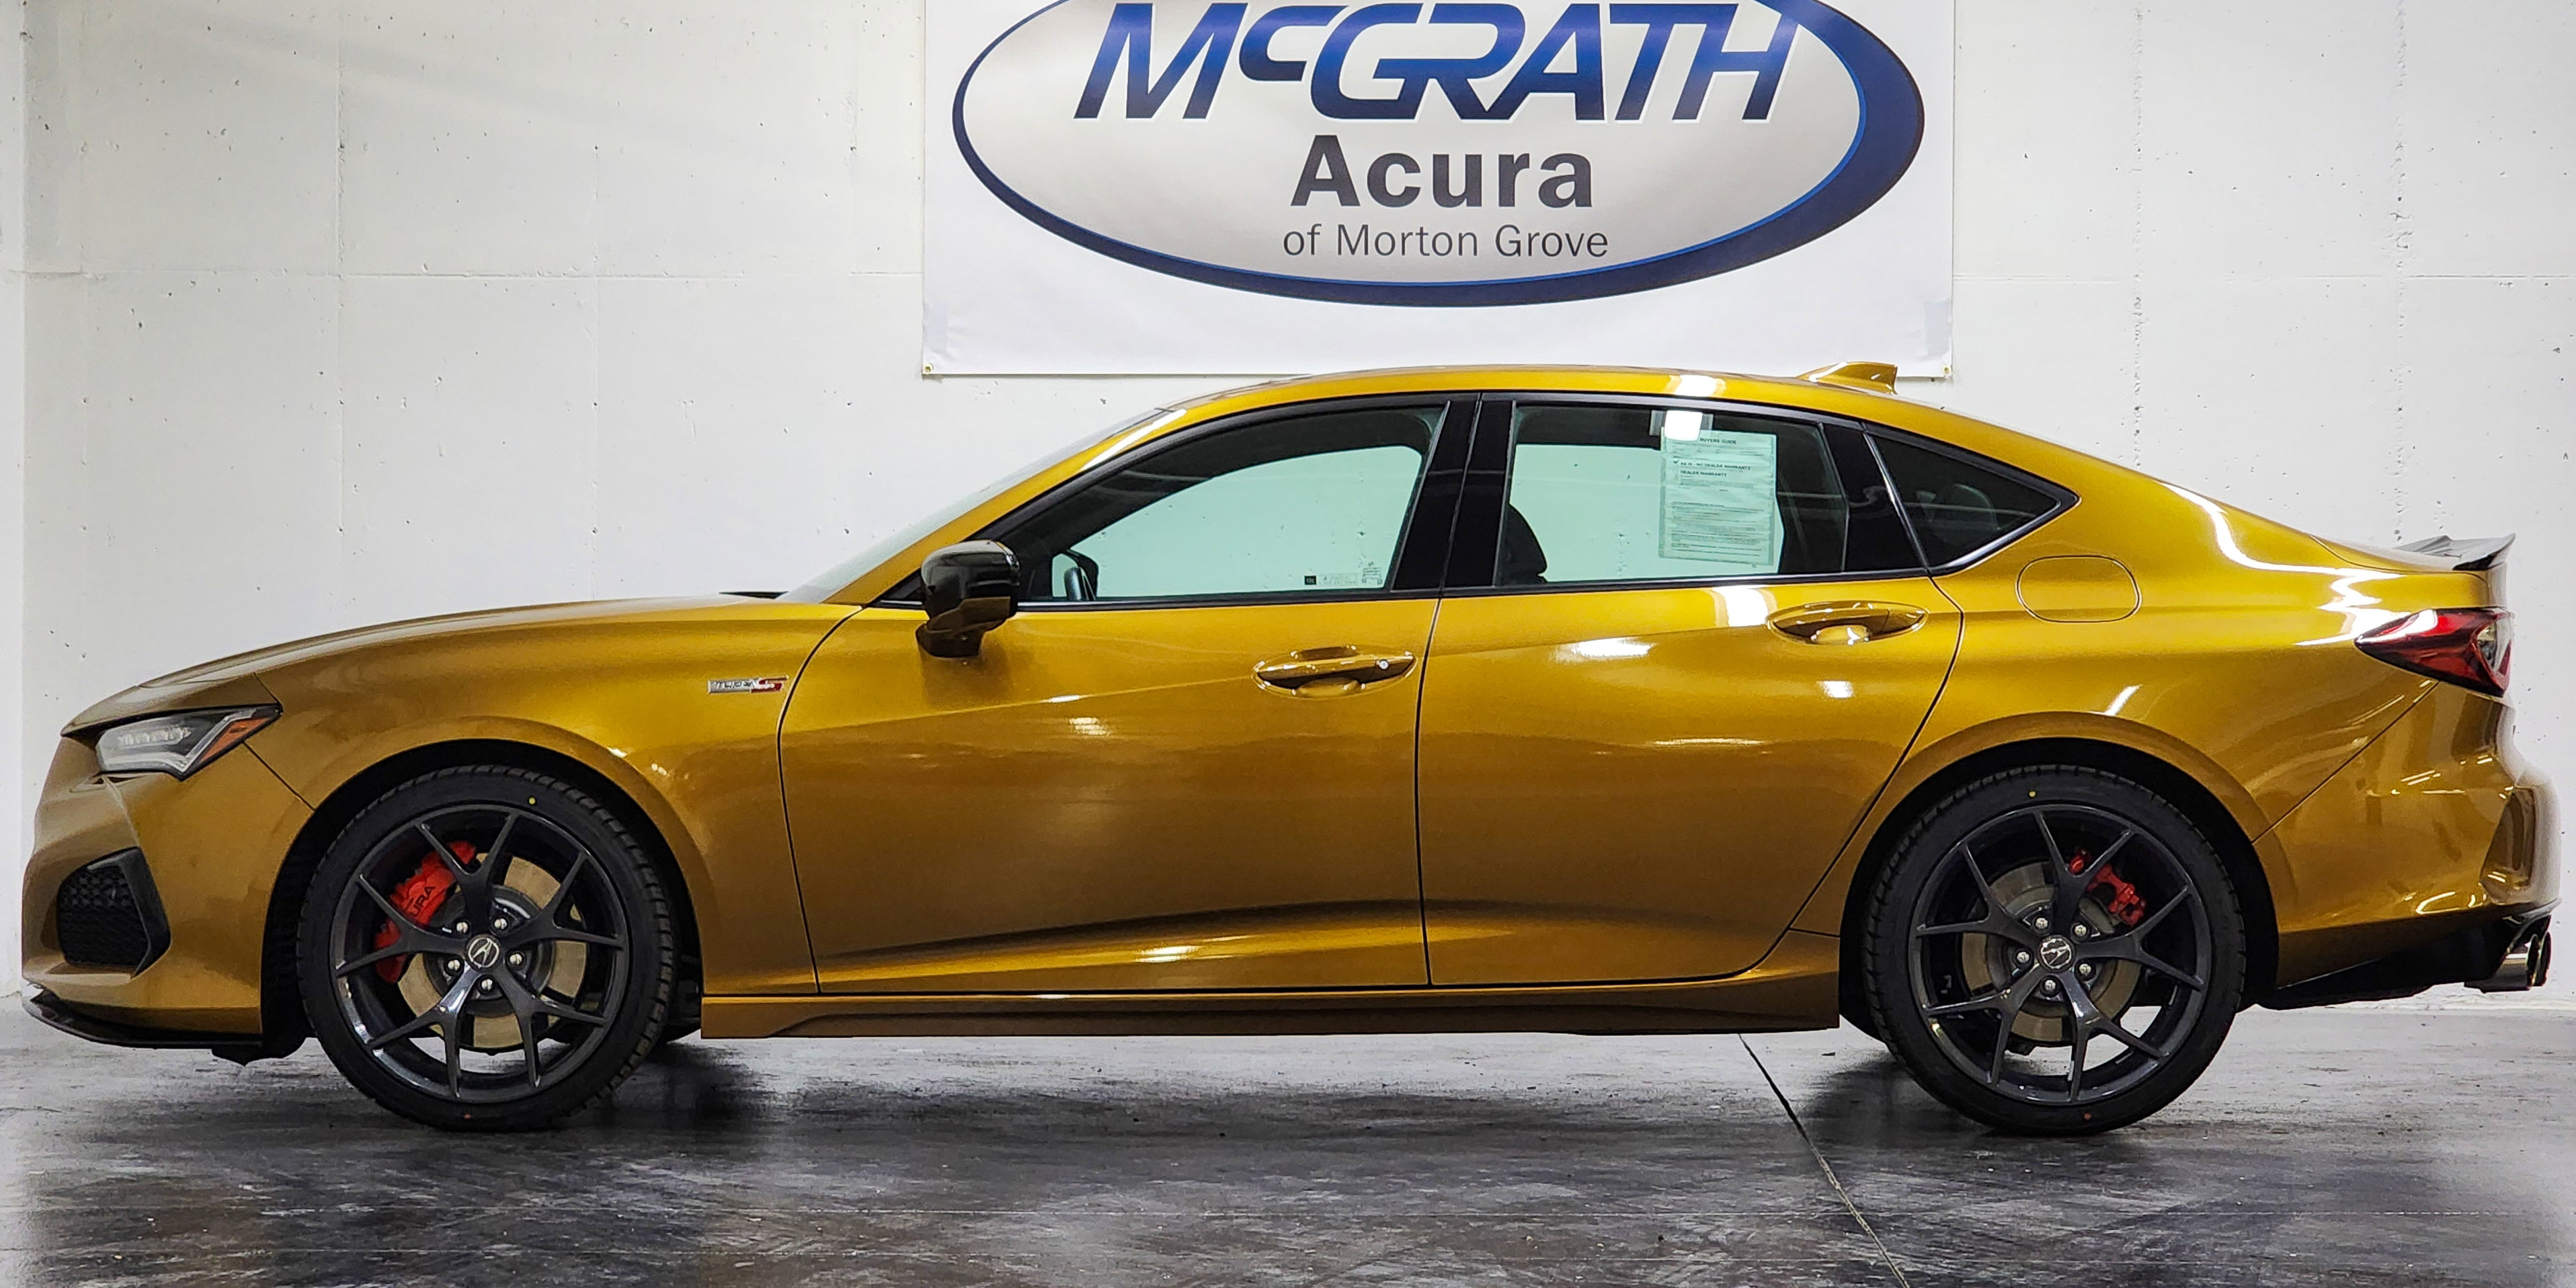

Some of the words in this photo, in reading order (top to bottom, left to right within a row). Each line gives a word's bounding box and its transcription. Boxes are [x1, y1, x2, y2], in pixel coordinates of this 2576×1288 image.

[1290, 134, 1593, 208] Acura
[1283, 223, 1322, 256] of
[1337, 224, 1478, 257] Morton
[1495, 224, 1609, 257] Grove
